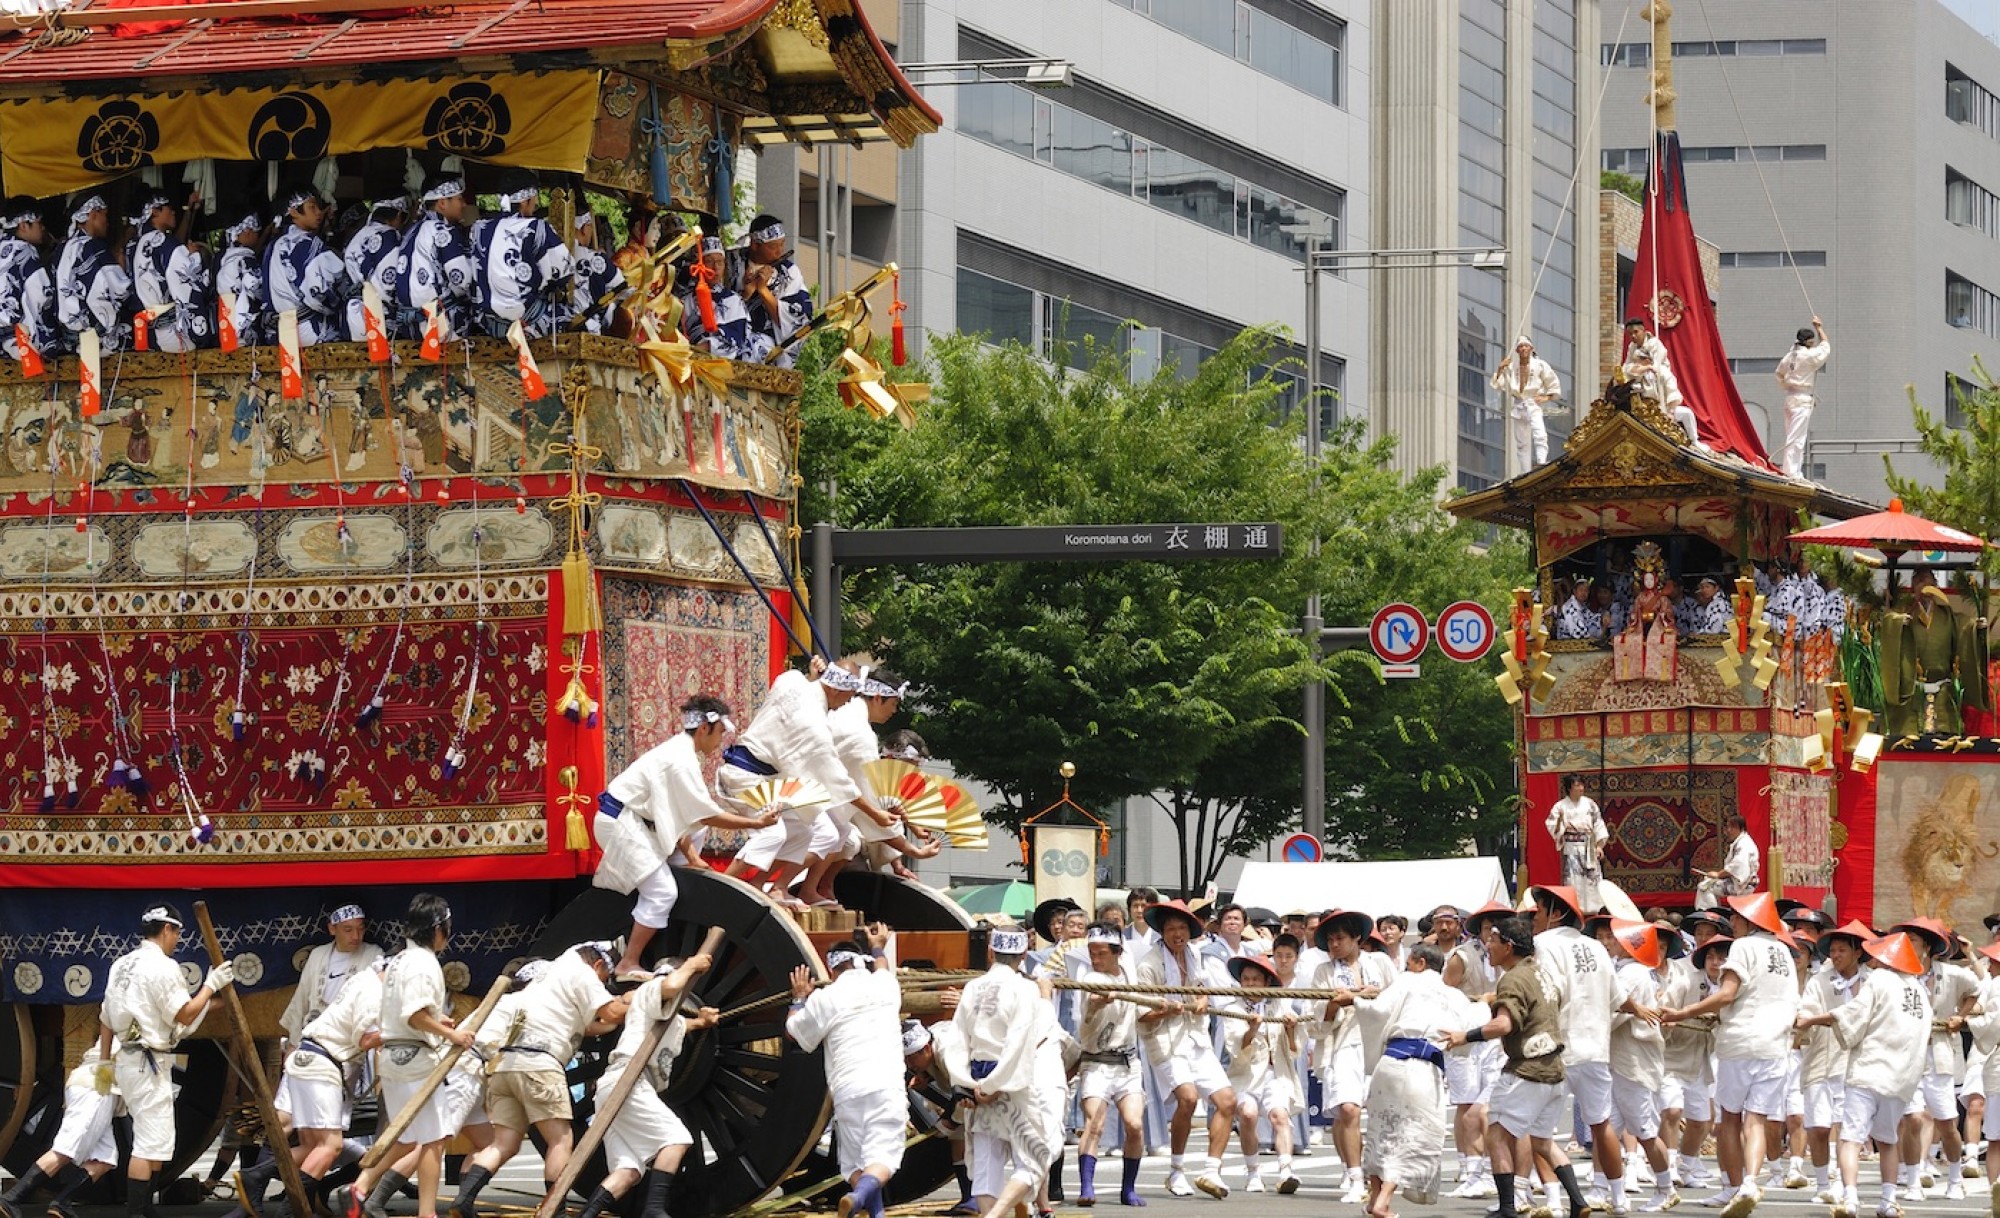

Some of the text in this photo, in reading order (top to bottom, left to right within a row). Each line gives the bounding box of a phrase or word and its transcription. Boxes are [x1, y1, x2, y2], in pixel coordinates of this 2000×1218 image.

[1064, 533, 1152, 546] Koromotana dori
[1164, 525, 1269, 550] 衣棚通
[1450, 618, 1481, 644] 50
